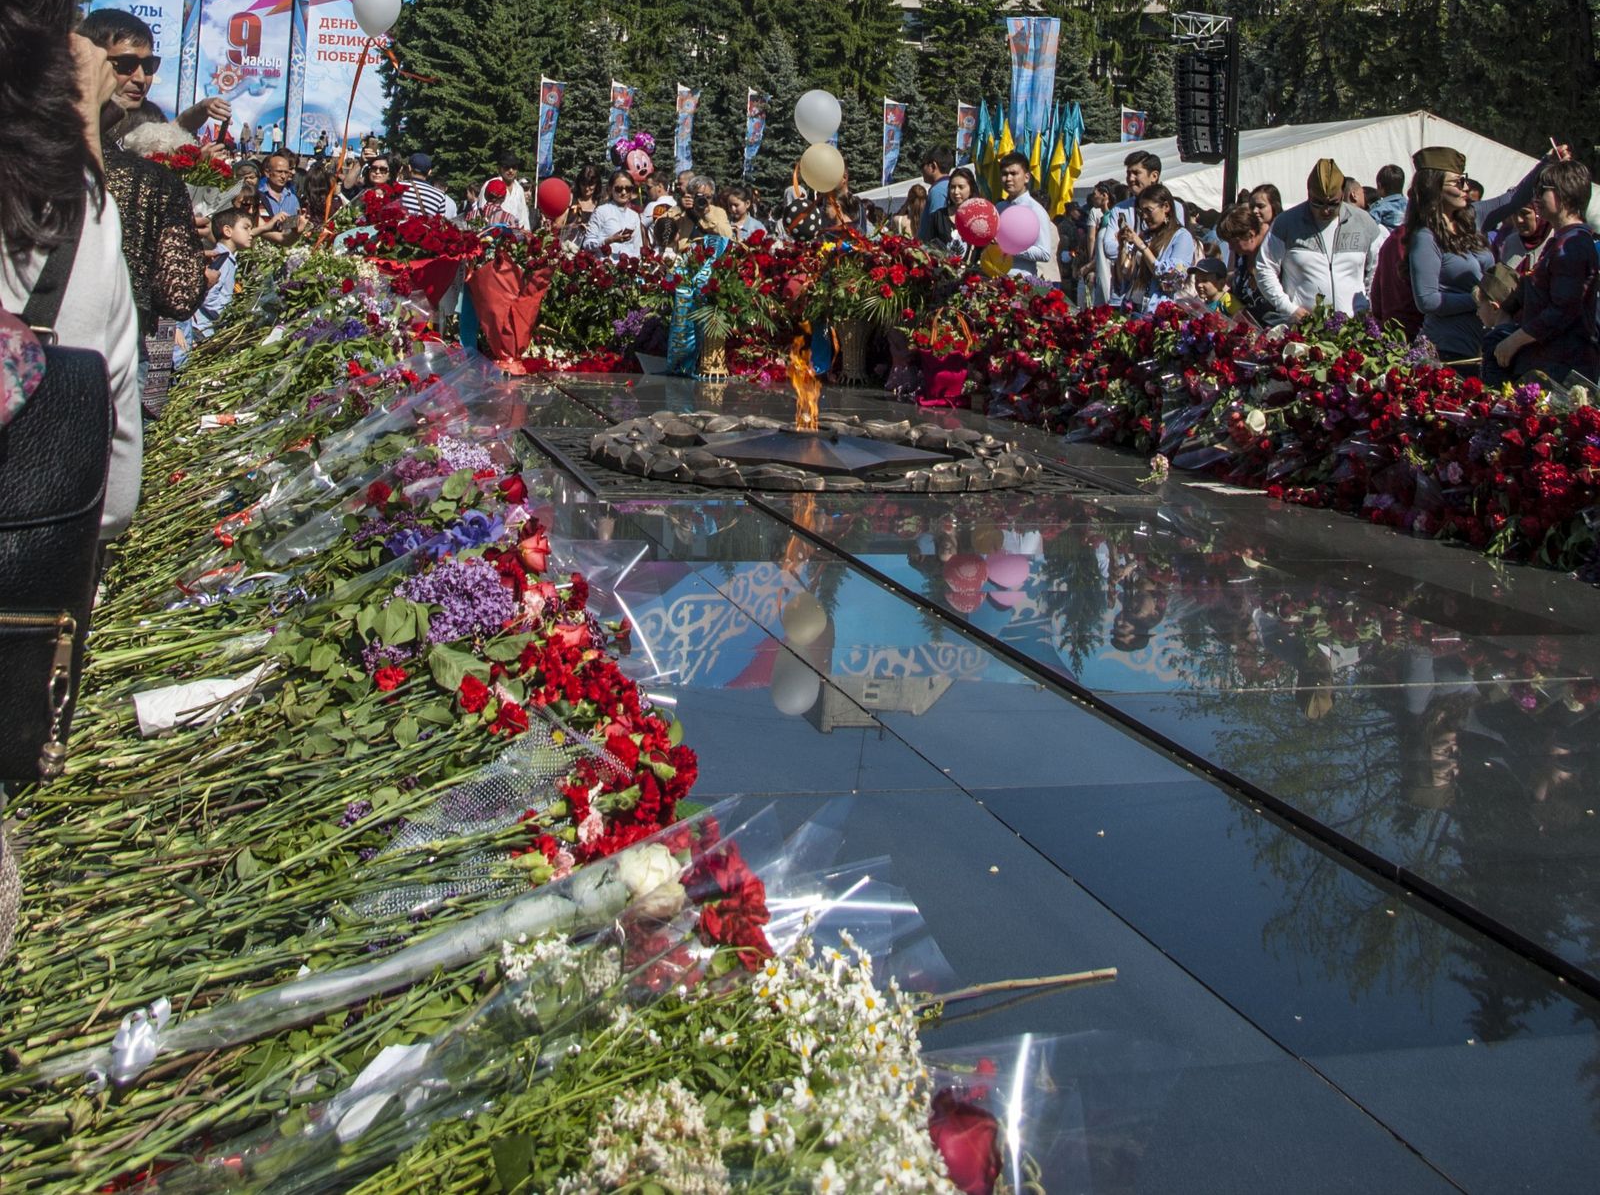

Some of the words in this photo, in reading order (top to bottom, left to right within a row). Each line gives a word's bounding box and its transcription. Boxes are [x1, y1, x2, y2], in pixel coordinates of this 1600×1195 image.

[319, 17, 358, 30] ДЕНЬ
[226, 11, 263, 67] 9
[318, 33, 388, 48] ВЕЛИКОЙ
[241, 55, 282, 70] мамыр
